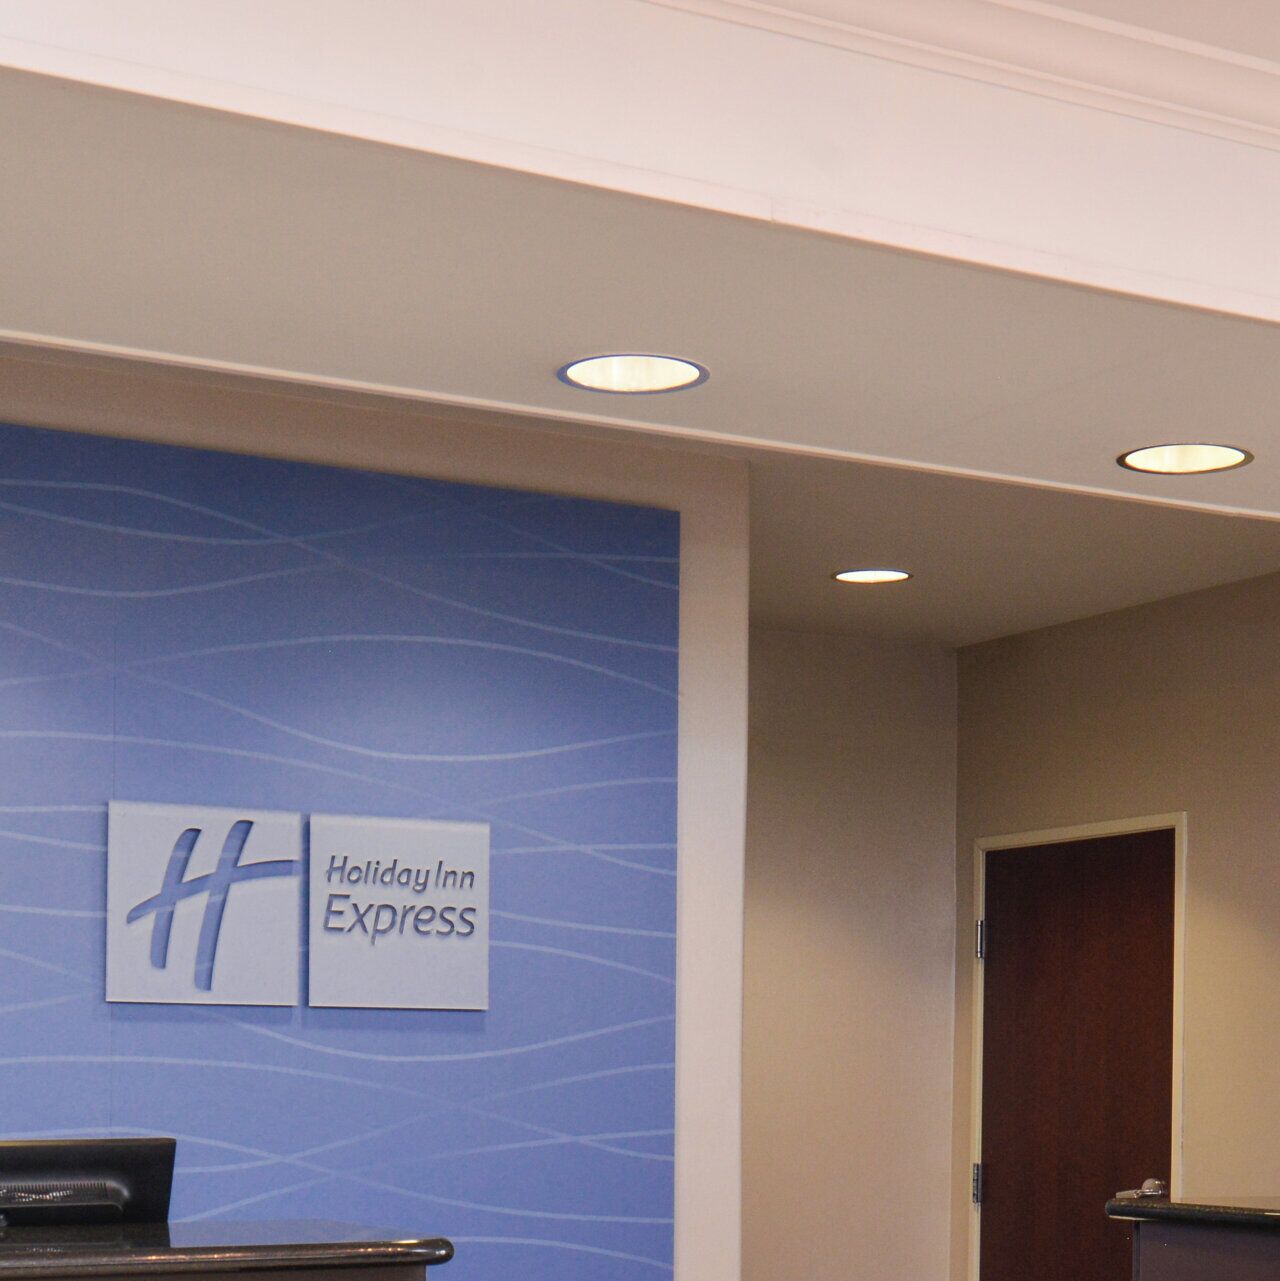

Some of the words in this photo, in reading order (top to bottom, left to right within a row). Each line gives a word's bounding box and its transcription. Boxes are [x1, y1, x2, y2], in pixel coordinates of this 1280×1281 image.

[326, 855, 431, 893] Holiday
[435, 860, 475, 888] Inn
[323, 893, 477, 946] Express
